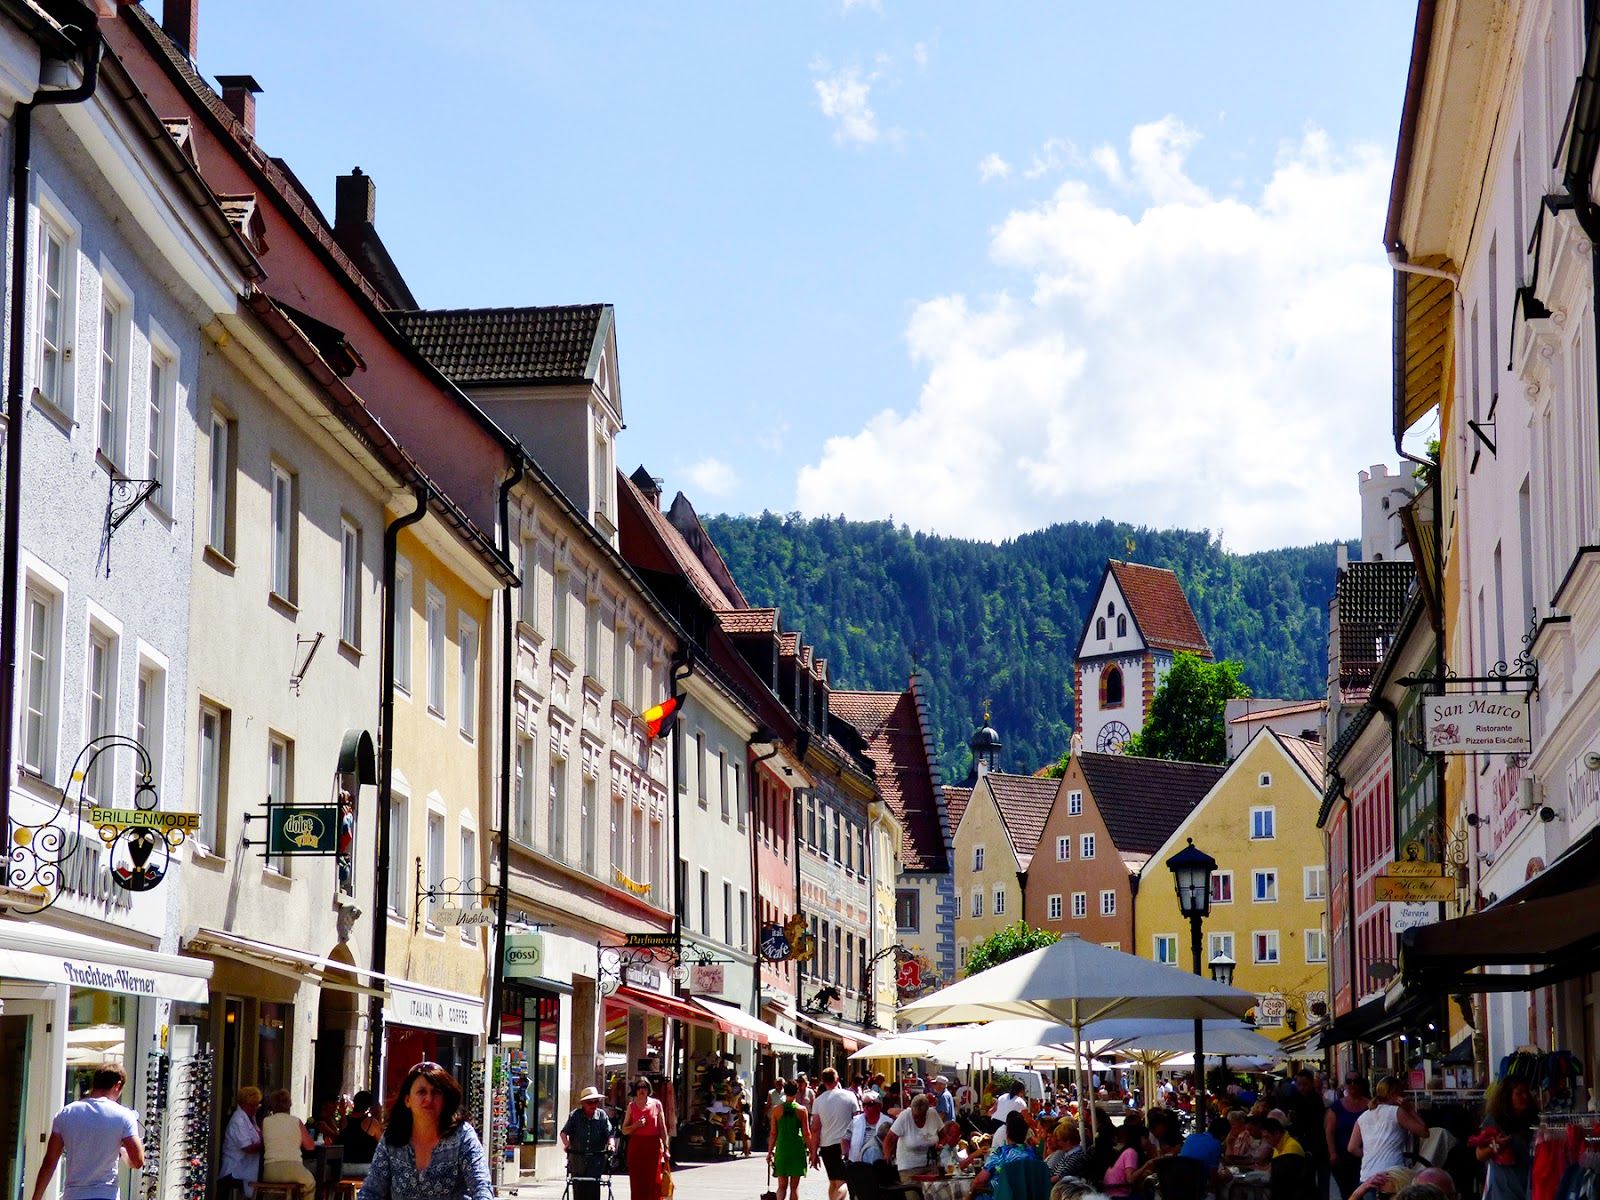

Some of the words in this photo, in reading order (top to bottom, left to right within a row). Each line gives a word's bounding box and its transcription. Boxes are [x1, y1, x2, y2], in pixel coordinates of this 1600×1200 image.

[1434, 704, 1463, 722] San
[1468, 699, 1521, 719] Marco
[1475, 724, 1513, 732] Ristorante
[1465, 737, 1494, 745] Pizzeria
[92, 810, 198, 827] BRILLENMODE
[286, 815, 313, 834] dolce
[1395, 880, 1436, 889] Hotel
[1381, 888, 1455, 899] Restaurant
[63, 961, 155, 993] Trachten-Werner
[410, 1000, 433, 1019] ITALIAN
[448, 1007, 468, 1025] COFFEE
